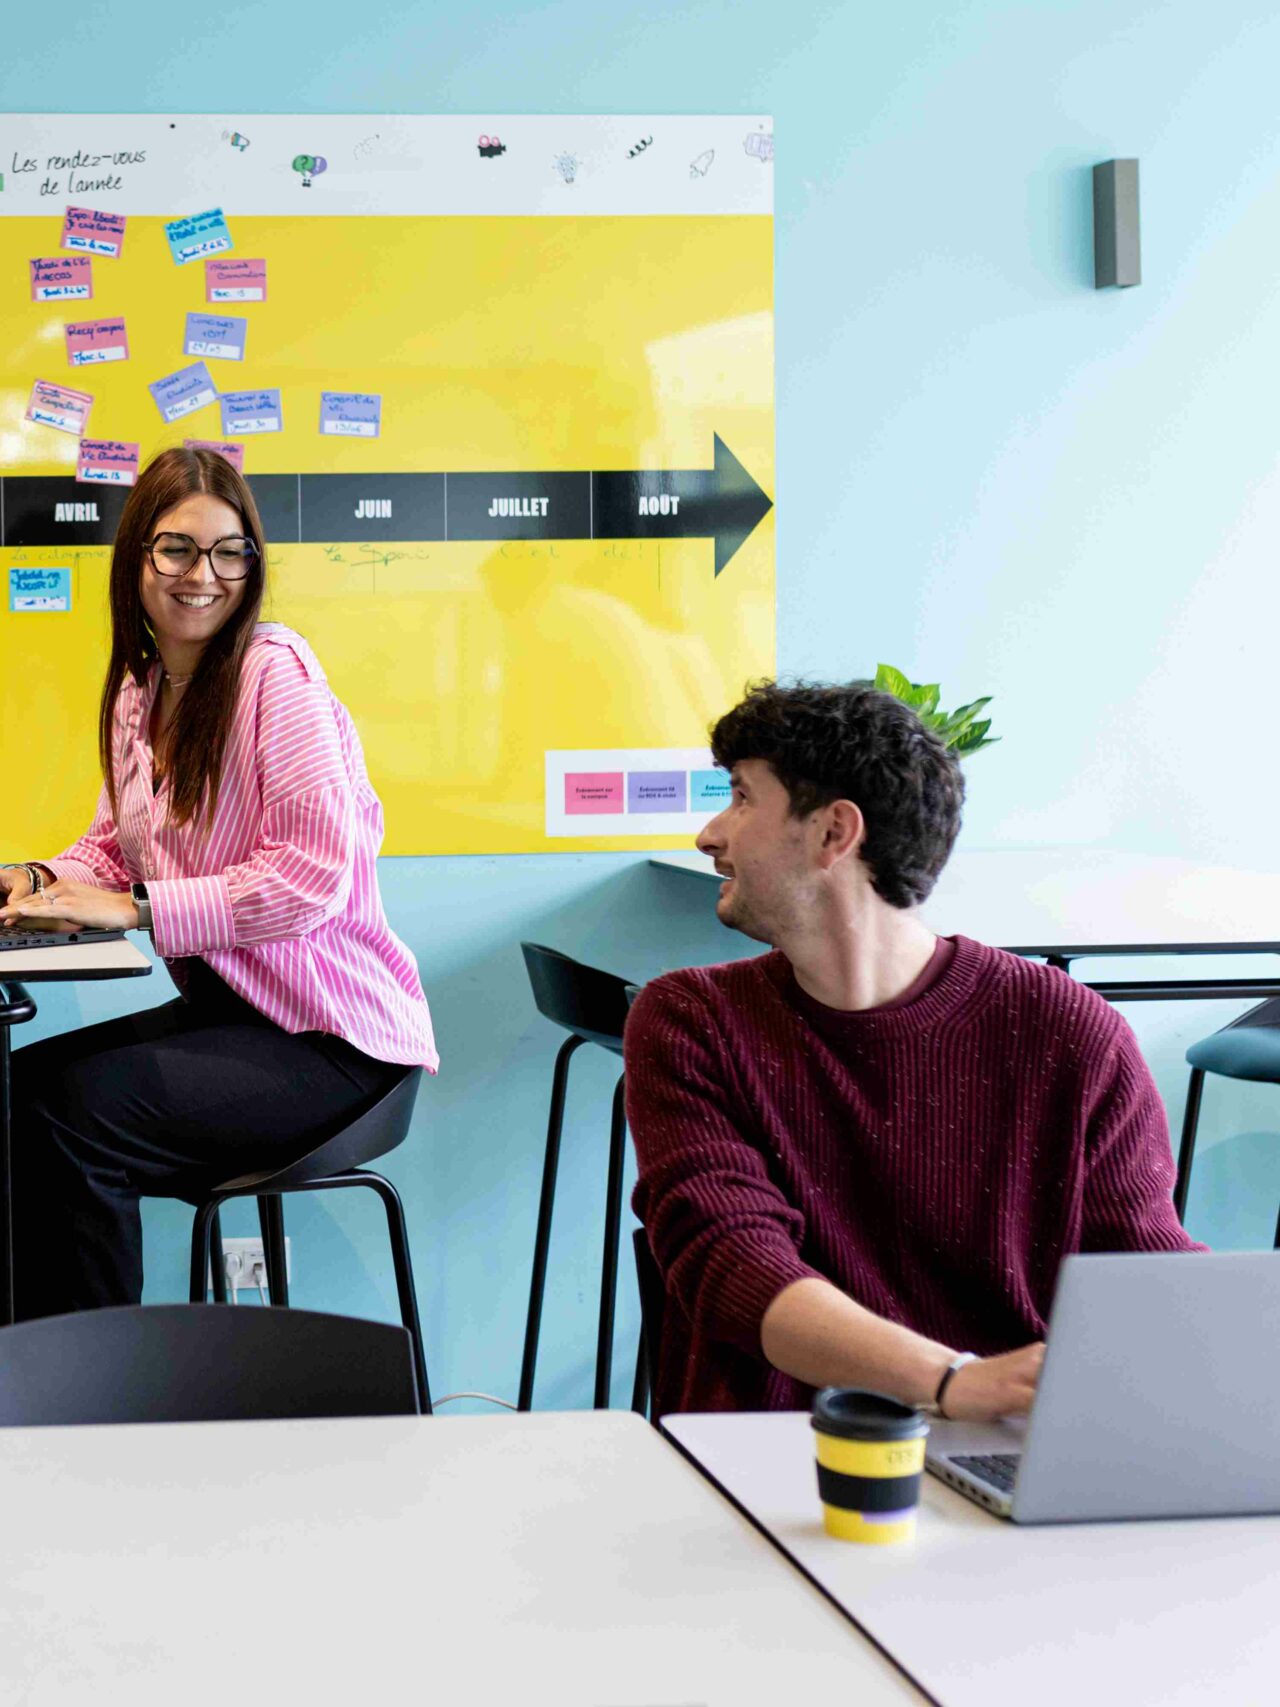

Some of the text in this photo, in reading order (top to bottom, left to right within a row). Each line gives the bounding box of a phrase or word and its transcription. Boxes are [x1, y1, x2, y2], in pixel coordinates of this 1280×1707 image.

[12, 150, 146, 173] Les rendez-vous
[40, 177, 60, 196] de
[55, 503, 100, 522] AVRIL
[354, 499, 392, 518] JUIN
[488, 497, 549, 517] JUILLET
[638, 494, 680, 516] AOÛT
